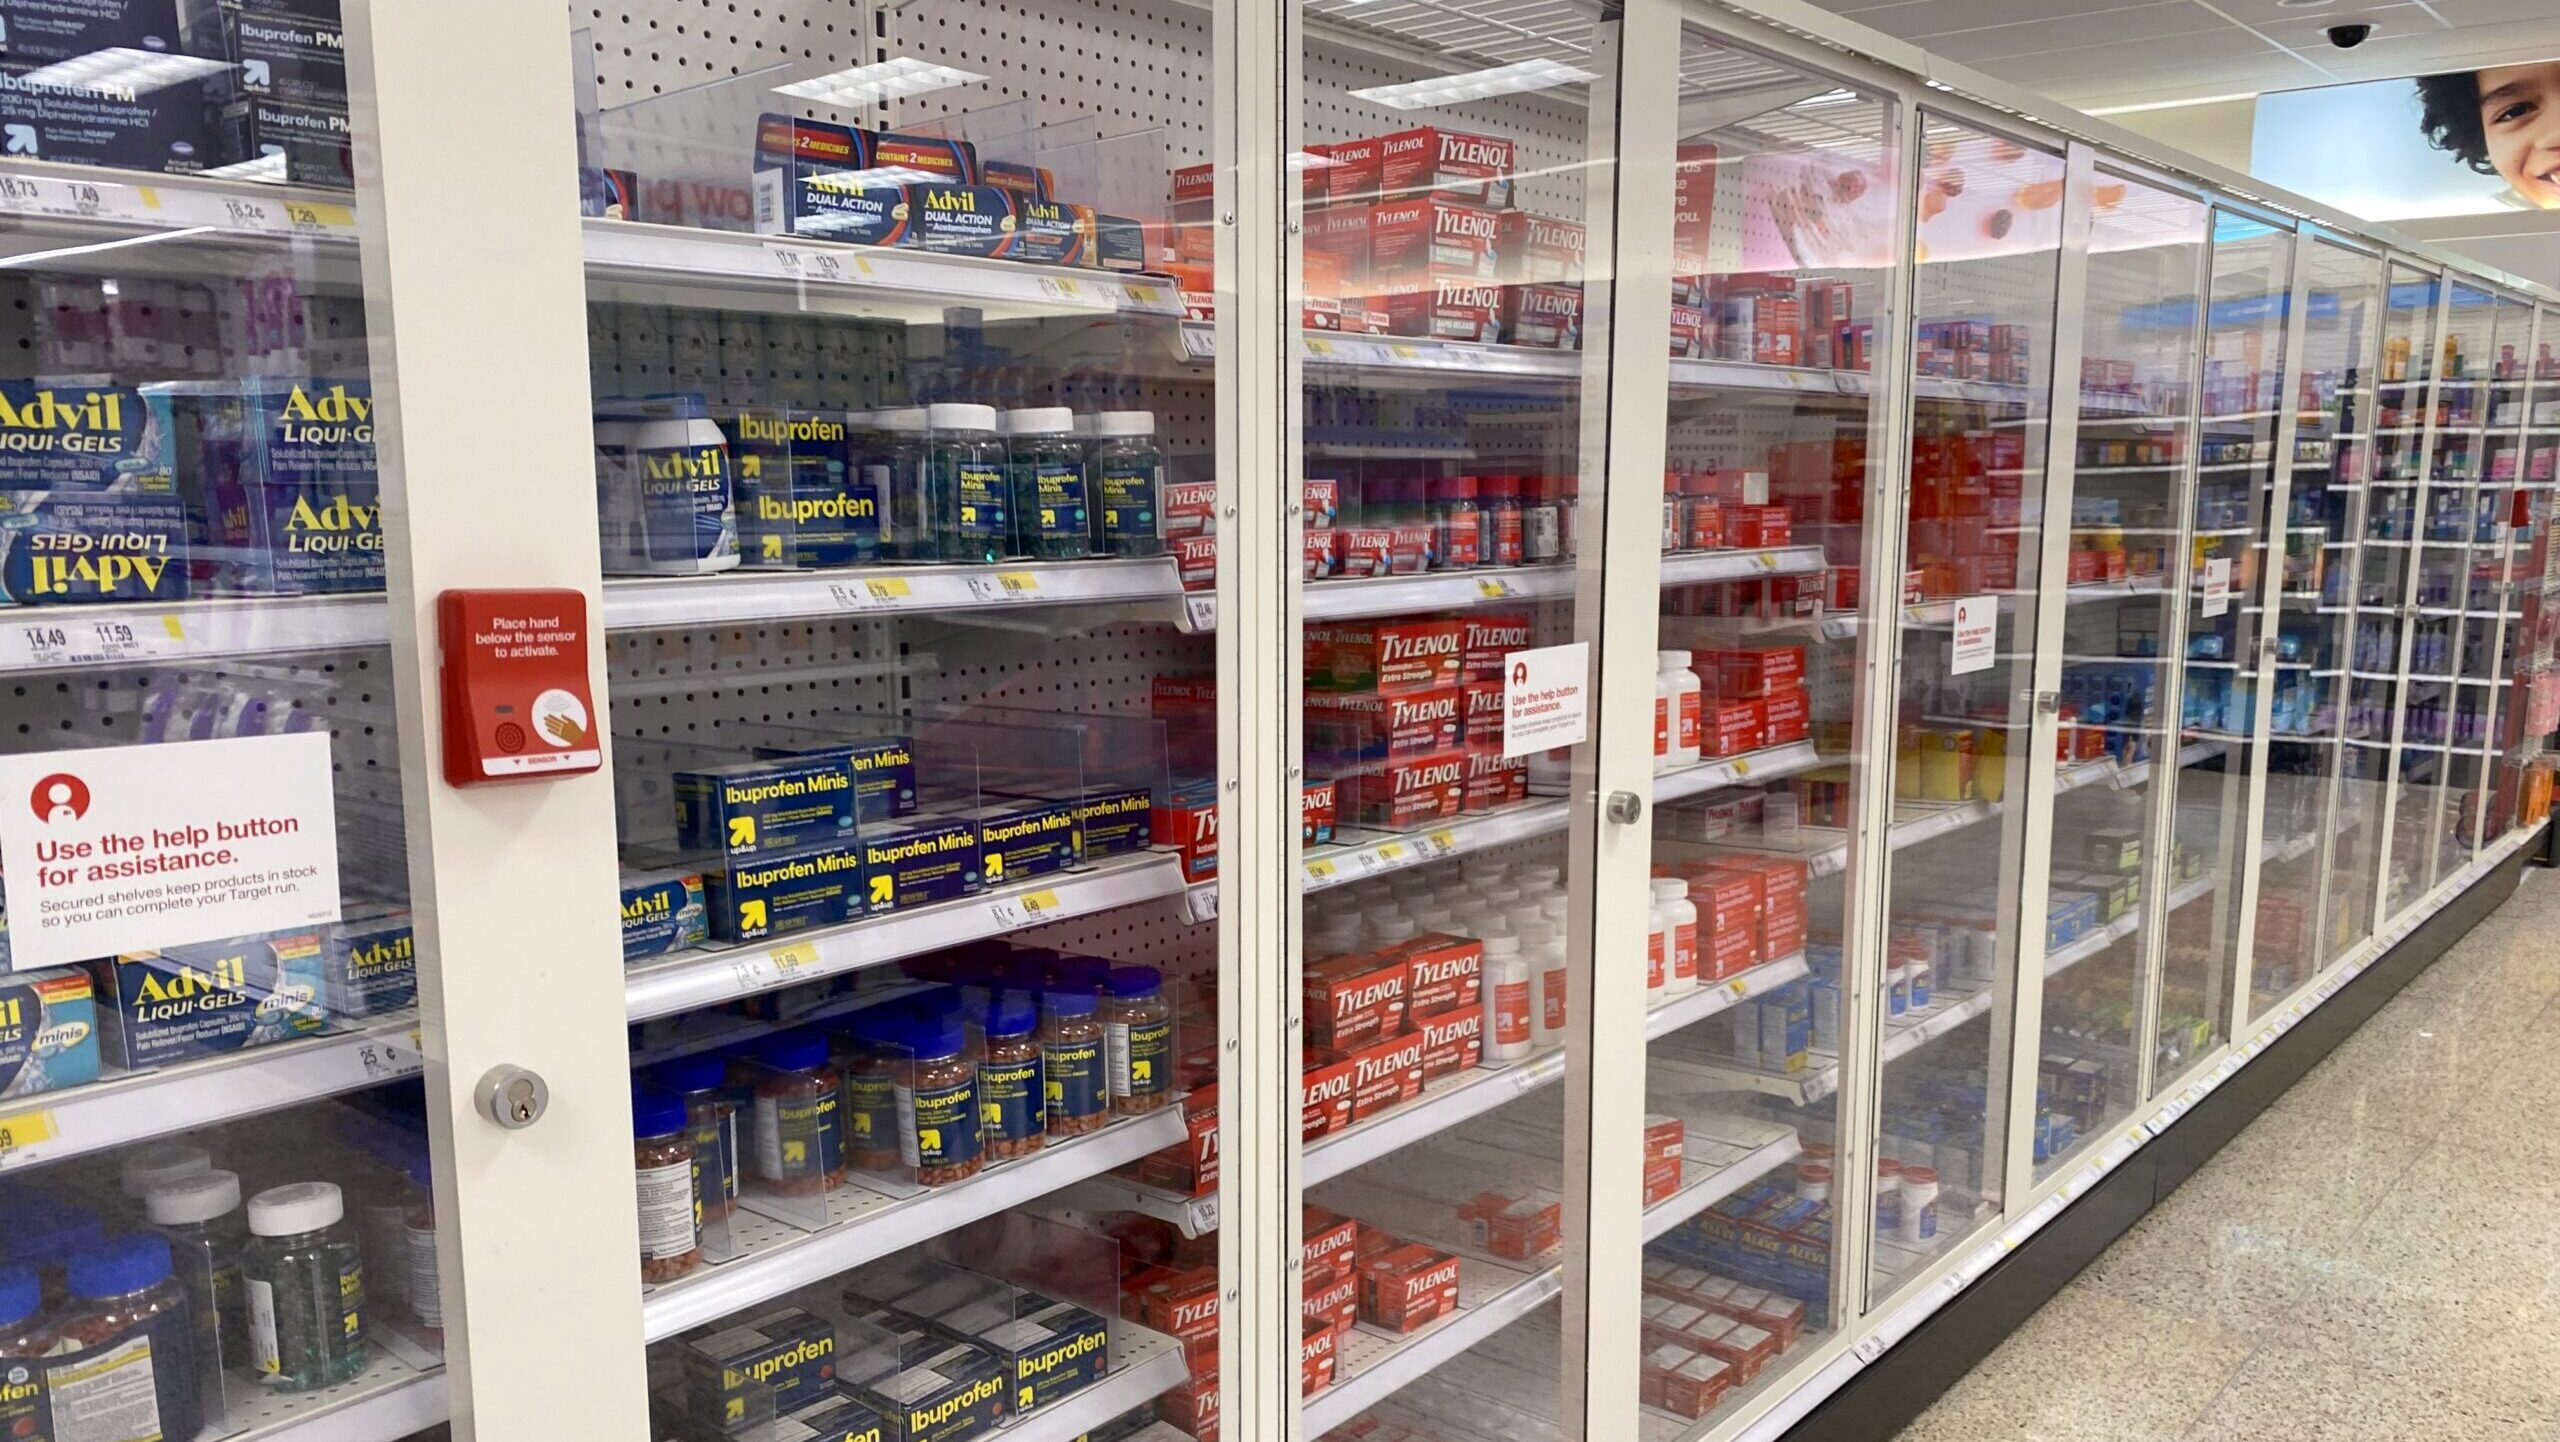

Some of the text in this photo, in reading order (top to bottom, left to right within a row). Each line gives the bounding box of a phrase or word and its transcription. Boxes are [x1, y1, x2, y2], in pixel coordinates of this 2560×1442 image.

[240, 23, 343, 48] Ibuprofen PM
[102, 86, 136, 103] PM
[38, 106, 128, 128] Diphenhydramine
[44, 97, 150, 119] Solubilized Ibuprofen
[258, 108, 326, 130] Ibuprofen
[801, 136, 850, 155] 2 MEDICINES
[1330, 147, 1371, 165] TYLENOL
[1383, 137, 1424, 157] TYLENOL
[1438, 133, 1508, 167] TYLENOL
[876, 150, 954, 167] CONTAINS 2 MEDICINES
[67, 184, 100, 202] 7.49
[807, 192, 883, 212] DUAL ACTION
[924, 188, 976, 212] Advil
[924, 210, 992, 226] DUAL ACTION
[1026, 202, 1060, 220] Advil
[1376, 209, 1420, 227] TYLENOL
[933, 222, 992, 234] Acetaminophen
[1046, 220, 1071, 231] ACTION
[1434, 205, 1497, 239] TYLENOL
[1528, 218, 1584, 251] TYLENOL
[1436, 278, 1500, 309] TYLENOL
[1520, 287, 1579, 317] TYLENOL
[0, 391, 122, 431] Advil
[739, 412, 844, 446] Ibuprofen
[71, 469, 101, 481] (NSAID)
[644, 449, 720, 480] Advil
[960, 471, 1000, 482] Ibuprofen
[960, 480, 986, 491] Minis
[1037, 474, 1078, 485] Ibuprofen
[1104, 477, 1145, 488] Ibuprofen
[1038, 483, 1063, 493] Minis
[1104, 485, 1127, 495] Minis
[759, 491, 874, 525] Ibuprofen
[1350, 532, 1390, 549] TYLENOL
[1394, 529, 1431, 545] TYLENOL
[32, 555, 172, 595] Advil
[277, 568, 292, 580] Pain
[493, 616, 559, 630] Place hand
[27, 628, 66, 649] 14.49
[96, 624, 134, 644] 11.59
[475, 631, 576, 644] below the sensor
[1335, 629, 1374, 645] TYLENOL
[1466, 624, 1528, 650] TYLENOL
[495, 645, 559, 658] to activate.
[1381, 633, 1460, 663] TYLENOL
[1382, 670, 1433, 683] Extra Strength
[1338, 696, 1385, 712] TYLENOL
[1467, 690, 1504, 715] TYLE
[1512, 695, 1526, 707] Use
[1528, 690, 1539, 703] the
[1392, 698, 1458, 728] TYLENOL
[1393, 734, 1434, 749] Extra Strength
[527, 756, 558, 765] SENSOR
[875, 749, 911, 770] Minis
[726, 772, 848, 804] Ibuprofen Minis
[1394, 761, 1461, 794] TYLENOL
[1121, 796, 1151, 812] Minis
[1394, 798, 1438, 815] Extra Strength
[982, 812, 1072, 843] Ibuprofen Minis
[37, 817, 299, 863] Use the help button
[730, 844, 757, 856] up&up
[867, 831, 975, 865] Ibuprofen Minis
[37, 849, 239, 888] for assistance.
[736, 852, 857, 888] Ibuprofen Minis
[40, 865, 318, 913] Secured shelves keep products in stock
[42, 881, 300, 928] so you can complete your Target run.
[620, 890, 671, 920] Advil
[742, 928, 768, 940] up&up
[346, 936, 412, 969] Advil
[132, 956, 245, 1006] Advil
[1413, 954, 1480, 990] TYLENOL
[263, 989, 308, 1010] minis
[1336, 977, 1404, 1019] TYLENOL
[1412, 990, 1456, 1009] Extra Strength
[39, 1027, 83, 1046] minis
[135, 1022, 199, 1041] Solubilized Ibuprofen
[137, 1021, 246, 1051] Pain Reducer (NSAID)
[1336, 1016, 1380, 1039] Extra Strength
[1423, 1016, 1480, 1052] TYLENOL
[360, 1047, 396, 1066] 25 ¢
[1356, 1042, 1422, 1088] TYLENOL
[1435, 1052, 1459, 1067] Strength
[980, 1068, 1035, 1085] Ibuprofen
[915, 1089, 971, 1110] Ibuprofen
[1356, 1085, 1399, 1108] Extra Strength
[1406, 1264, 1457, 1299] TYLENOL
[1418, 1298, 1437, 1314] Strength
[724, 1337, 833, 1390] Ibuprofen
[1017, 1330, 1106, 1380] Ibuprofen
[911, 1375, 1003, 1434] Ibuprofen
